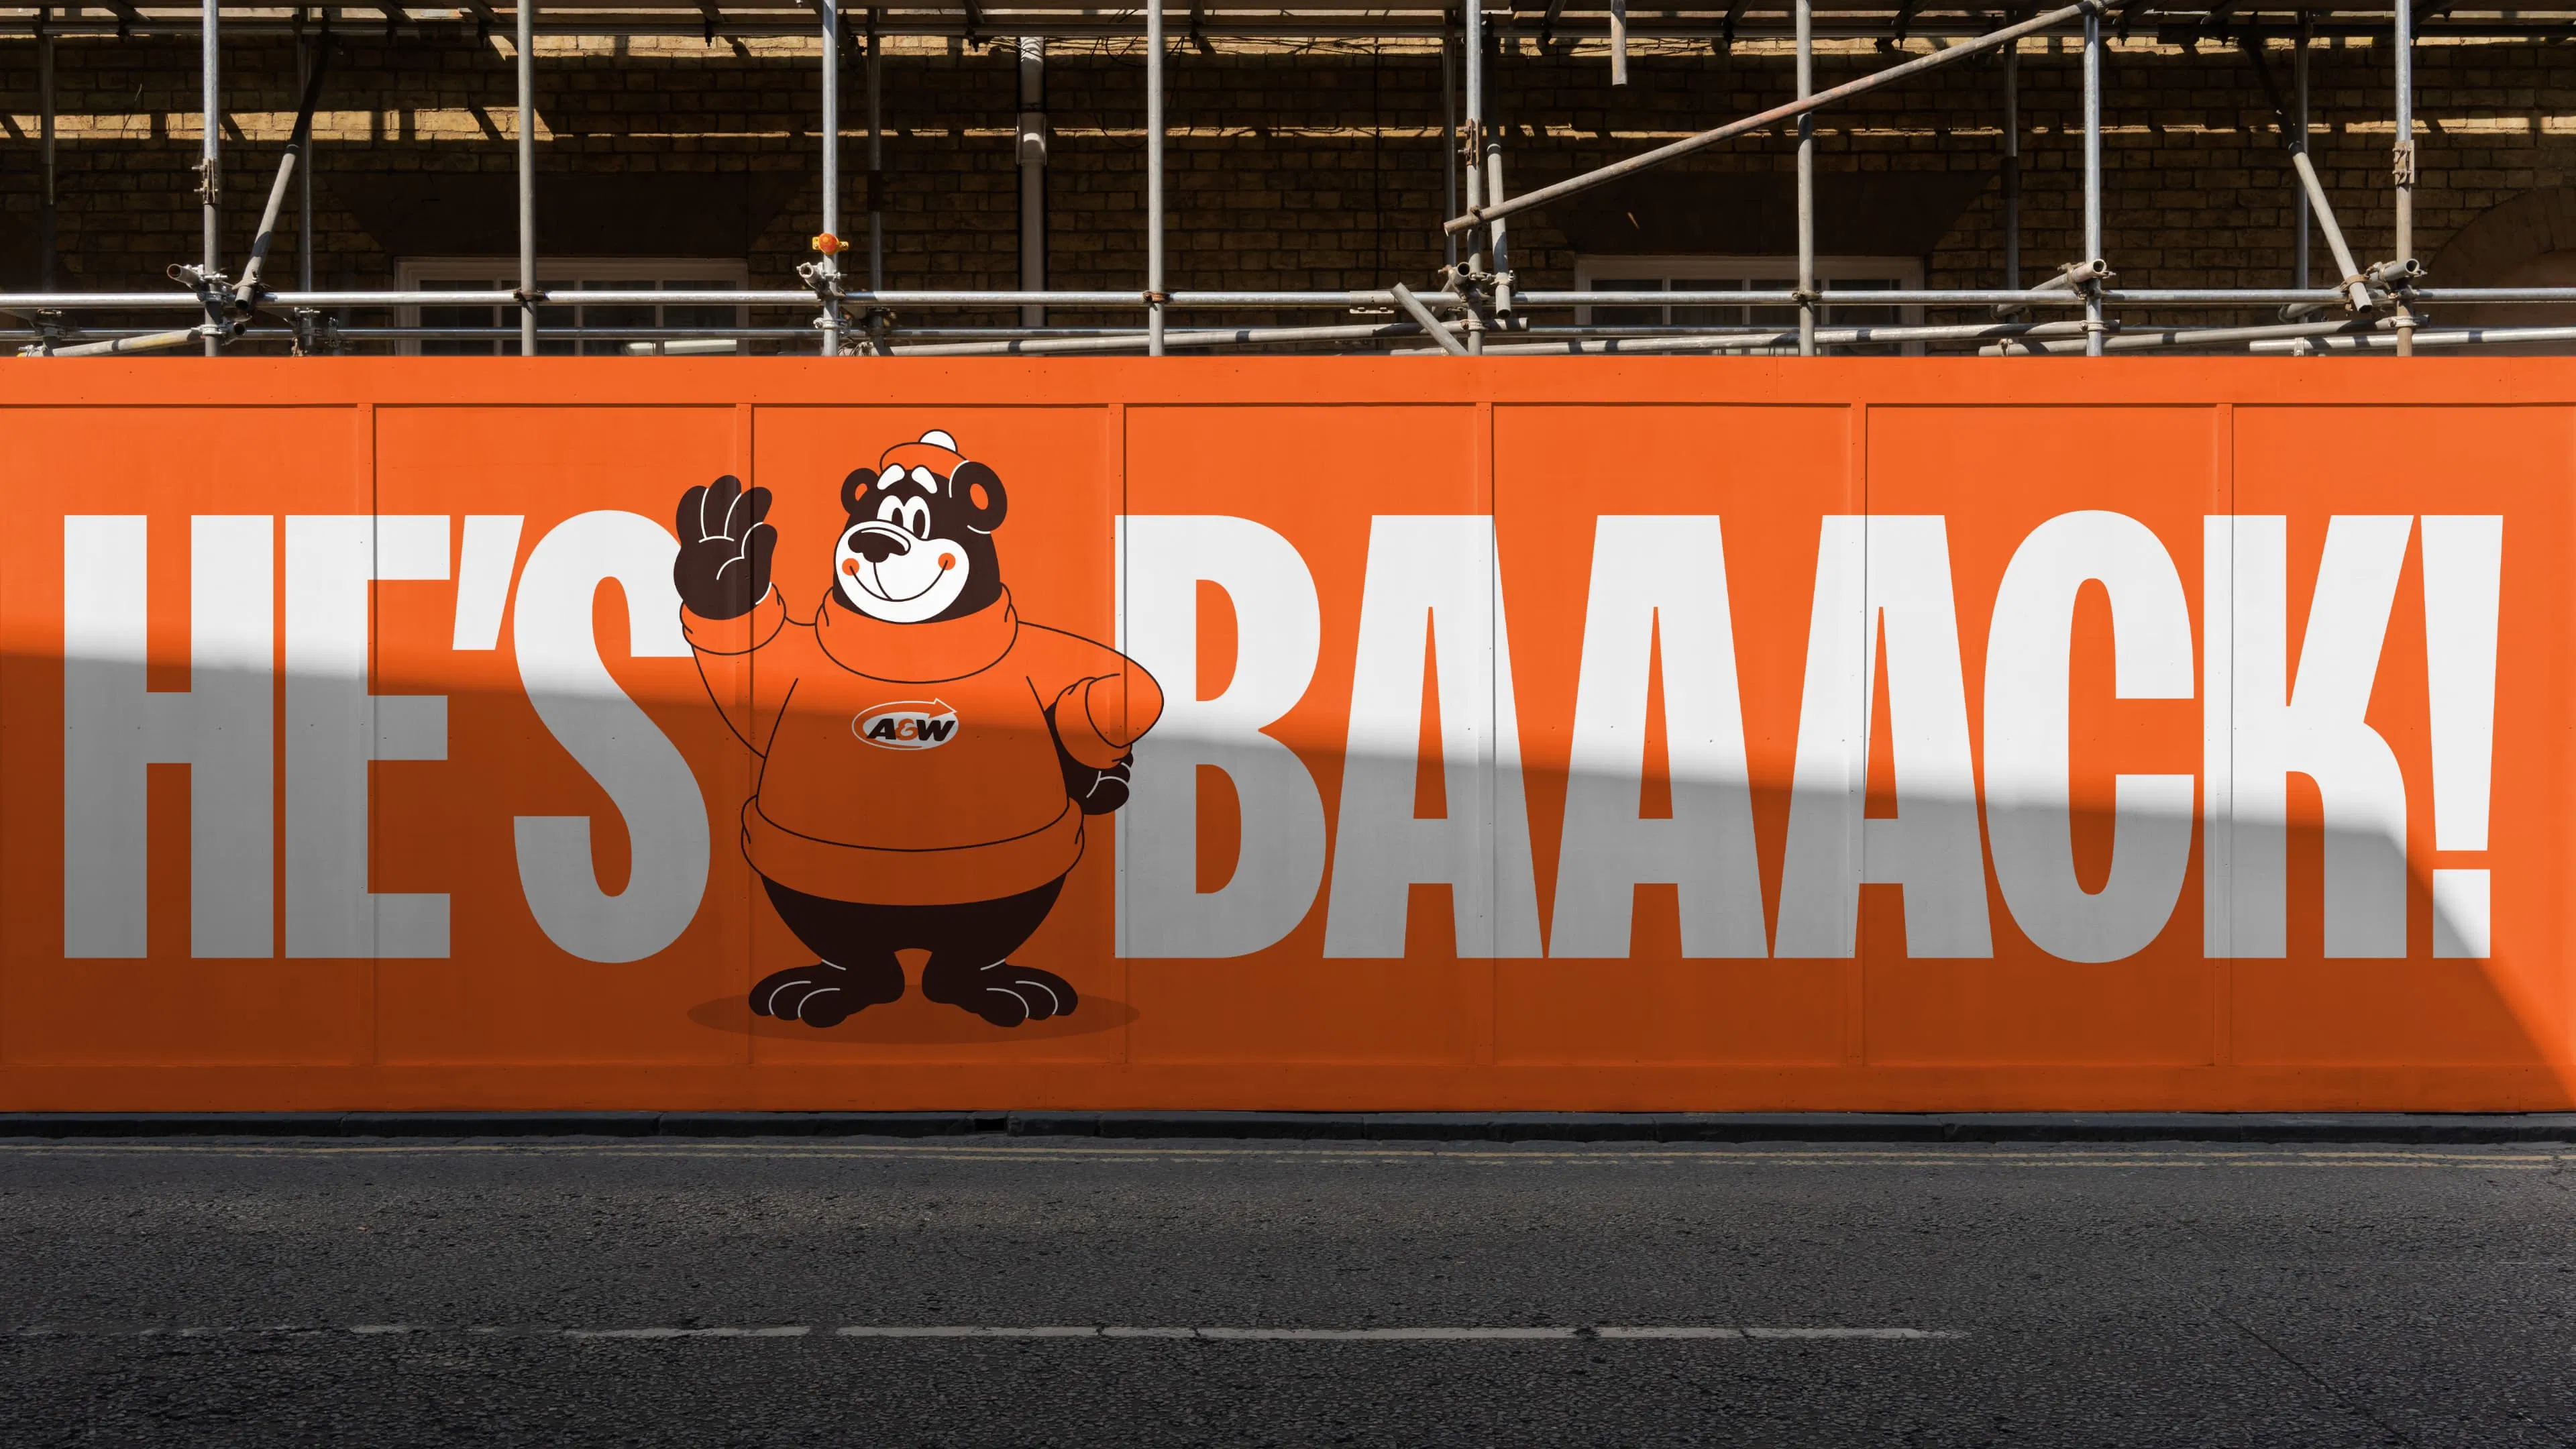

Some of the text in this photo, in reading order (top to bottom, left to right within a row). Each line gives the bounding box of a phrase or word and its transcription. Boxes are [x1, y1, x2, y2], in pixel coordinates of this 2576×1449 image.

[64, 510, 2504, 963] HE'S BAAACK!
[866, 718, 956, 742] A&W
